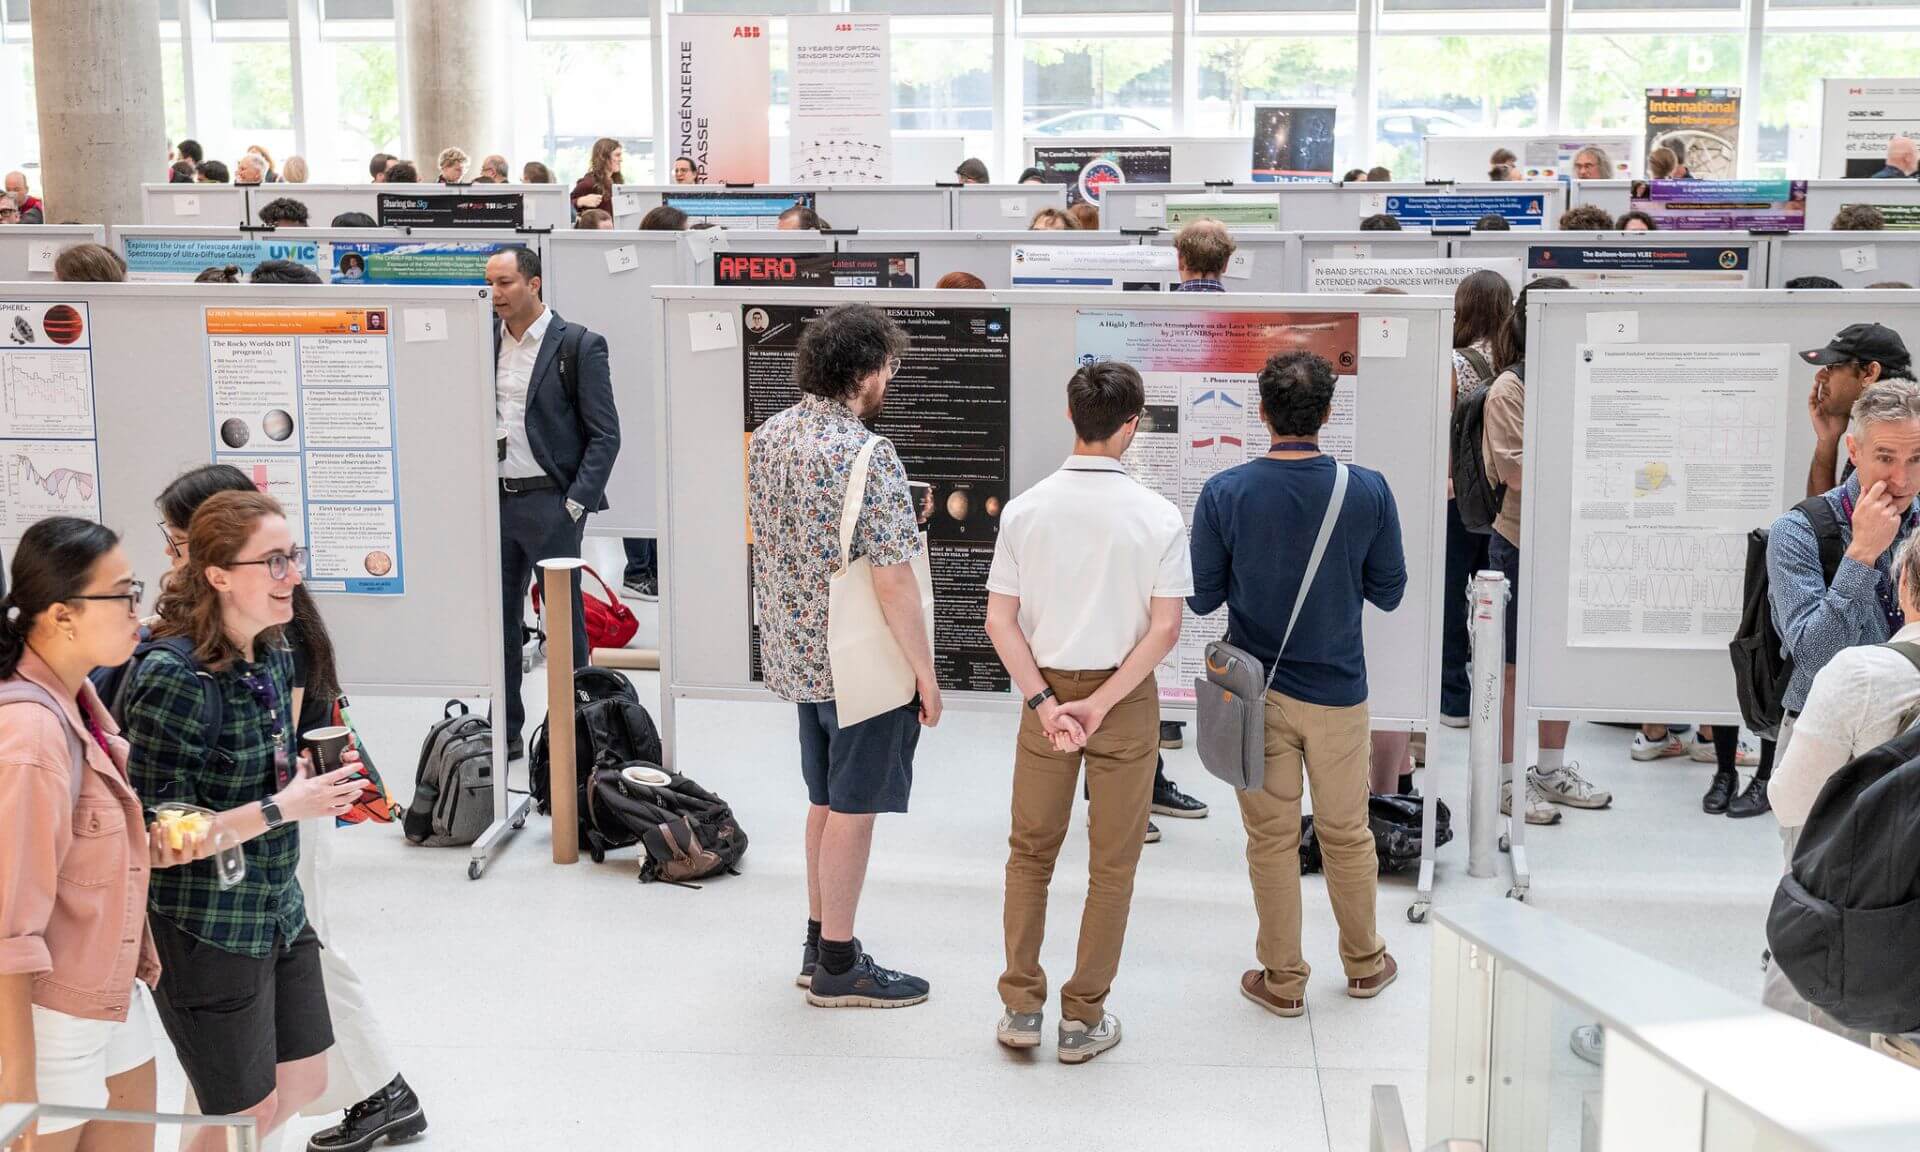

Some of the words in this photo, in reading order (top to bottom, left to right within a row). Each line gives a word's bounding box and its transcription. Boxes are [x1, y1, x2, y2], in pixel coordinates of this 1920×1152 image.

[733, 26, 760, 38] ABB
[678, 41, 692, 157] INGÉNIERIE
[1649, 99, 1737, 113] International
[1648, 114, 1680, 125] Gemini
[1845, 142, 1856, 151] et
[383, 199, 406, 209] Sharing
[407, 199, 416, 208] the
[417, 199, 428, 210] Sky
[128, 241, 159, 251] Exploring
[161, 242, 171, 250] the
[174, 242, 184, 250] Use
[185, 242, 193, 250] of
[196, 243, 230, 252] Telescope
[231, 243, 254, 252] Arrays
[356, 244, 370, 252] TSI
[128, 250, 172, 259] Spectroscopy
[173, 250, 181, 258] of
[181, 250, 225, 258] Ultra-Diffuse
[227, 251, 256, 259] Galaxies
[270, 245, 315, 260] UVIC
[720, 257, 796, 280] APERO
[832, 260, 855, 268] Latest
[1315, 267, 1346, 276] IN-BAND
[1348, 267, 1388, 276] SPECTRAL
[1390, 267, 1414, 276] INDEX
[1415, 267, 1465, 276] TECHNIQUES
[1315, 278, 1353, 286] EXTENDED
[1355, 278, 1380, 286] RADIO
[1383, 278, 1421, 286] SOURCES
[1422, 278, 1443, 286] WITH
[425, 323, 431, 331] 5
[716, 324, 722, 332] 4
[1099, 321, 1105, 329] A
[1106, 321, 1128, 330] Highly
[1129, 321, 1162, 329] Reflective
[1163, 321, 1205, 331] Atmosphere
[1206, 321, 1214, 329] on
[1216, 321, 1227, 329] the
[1229, 321, 1245, 329] Lava
[1617, 324, 1624, 333] 2
[1161, 330, 1169, 338] by
[1382, 329, 1389, 339] 3
[232, 349, 262, 357] program
